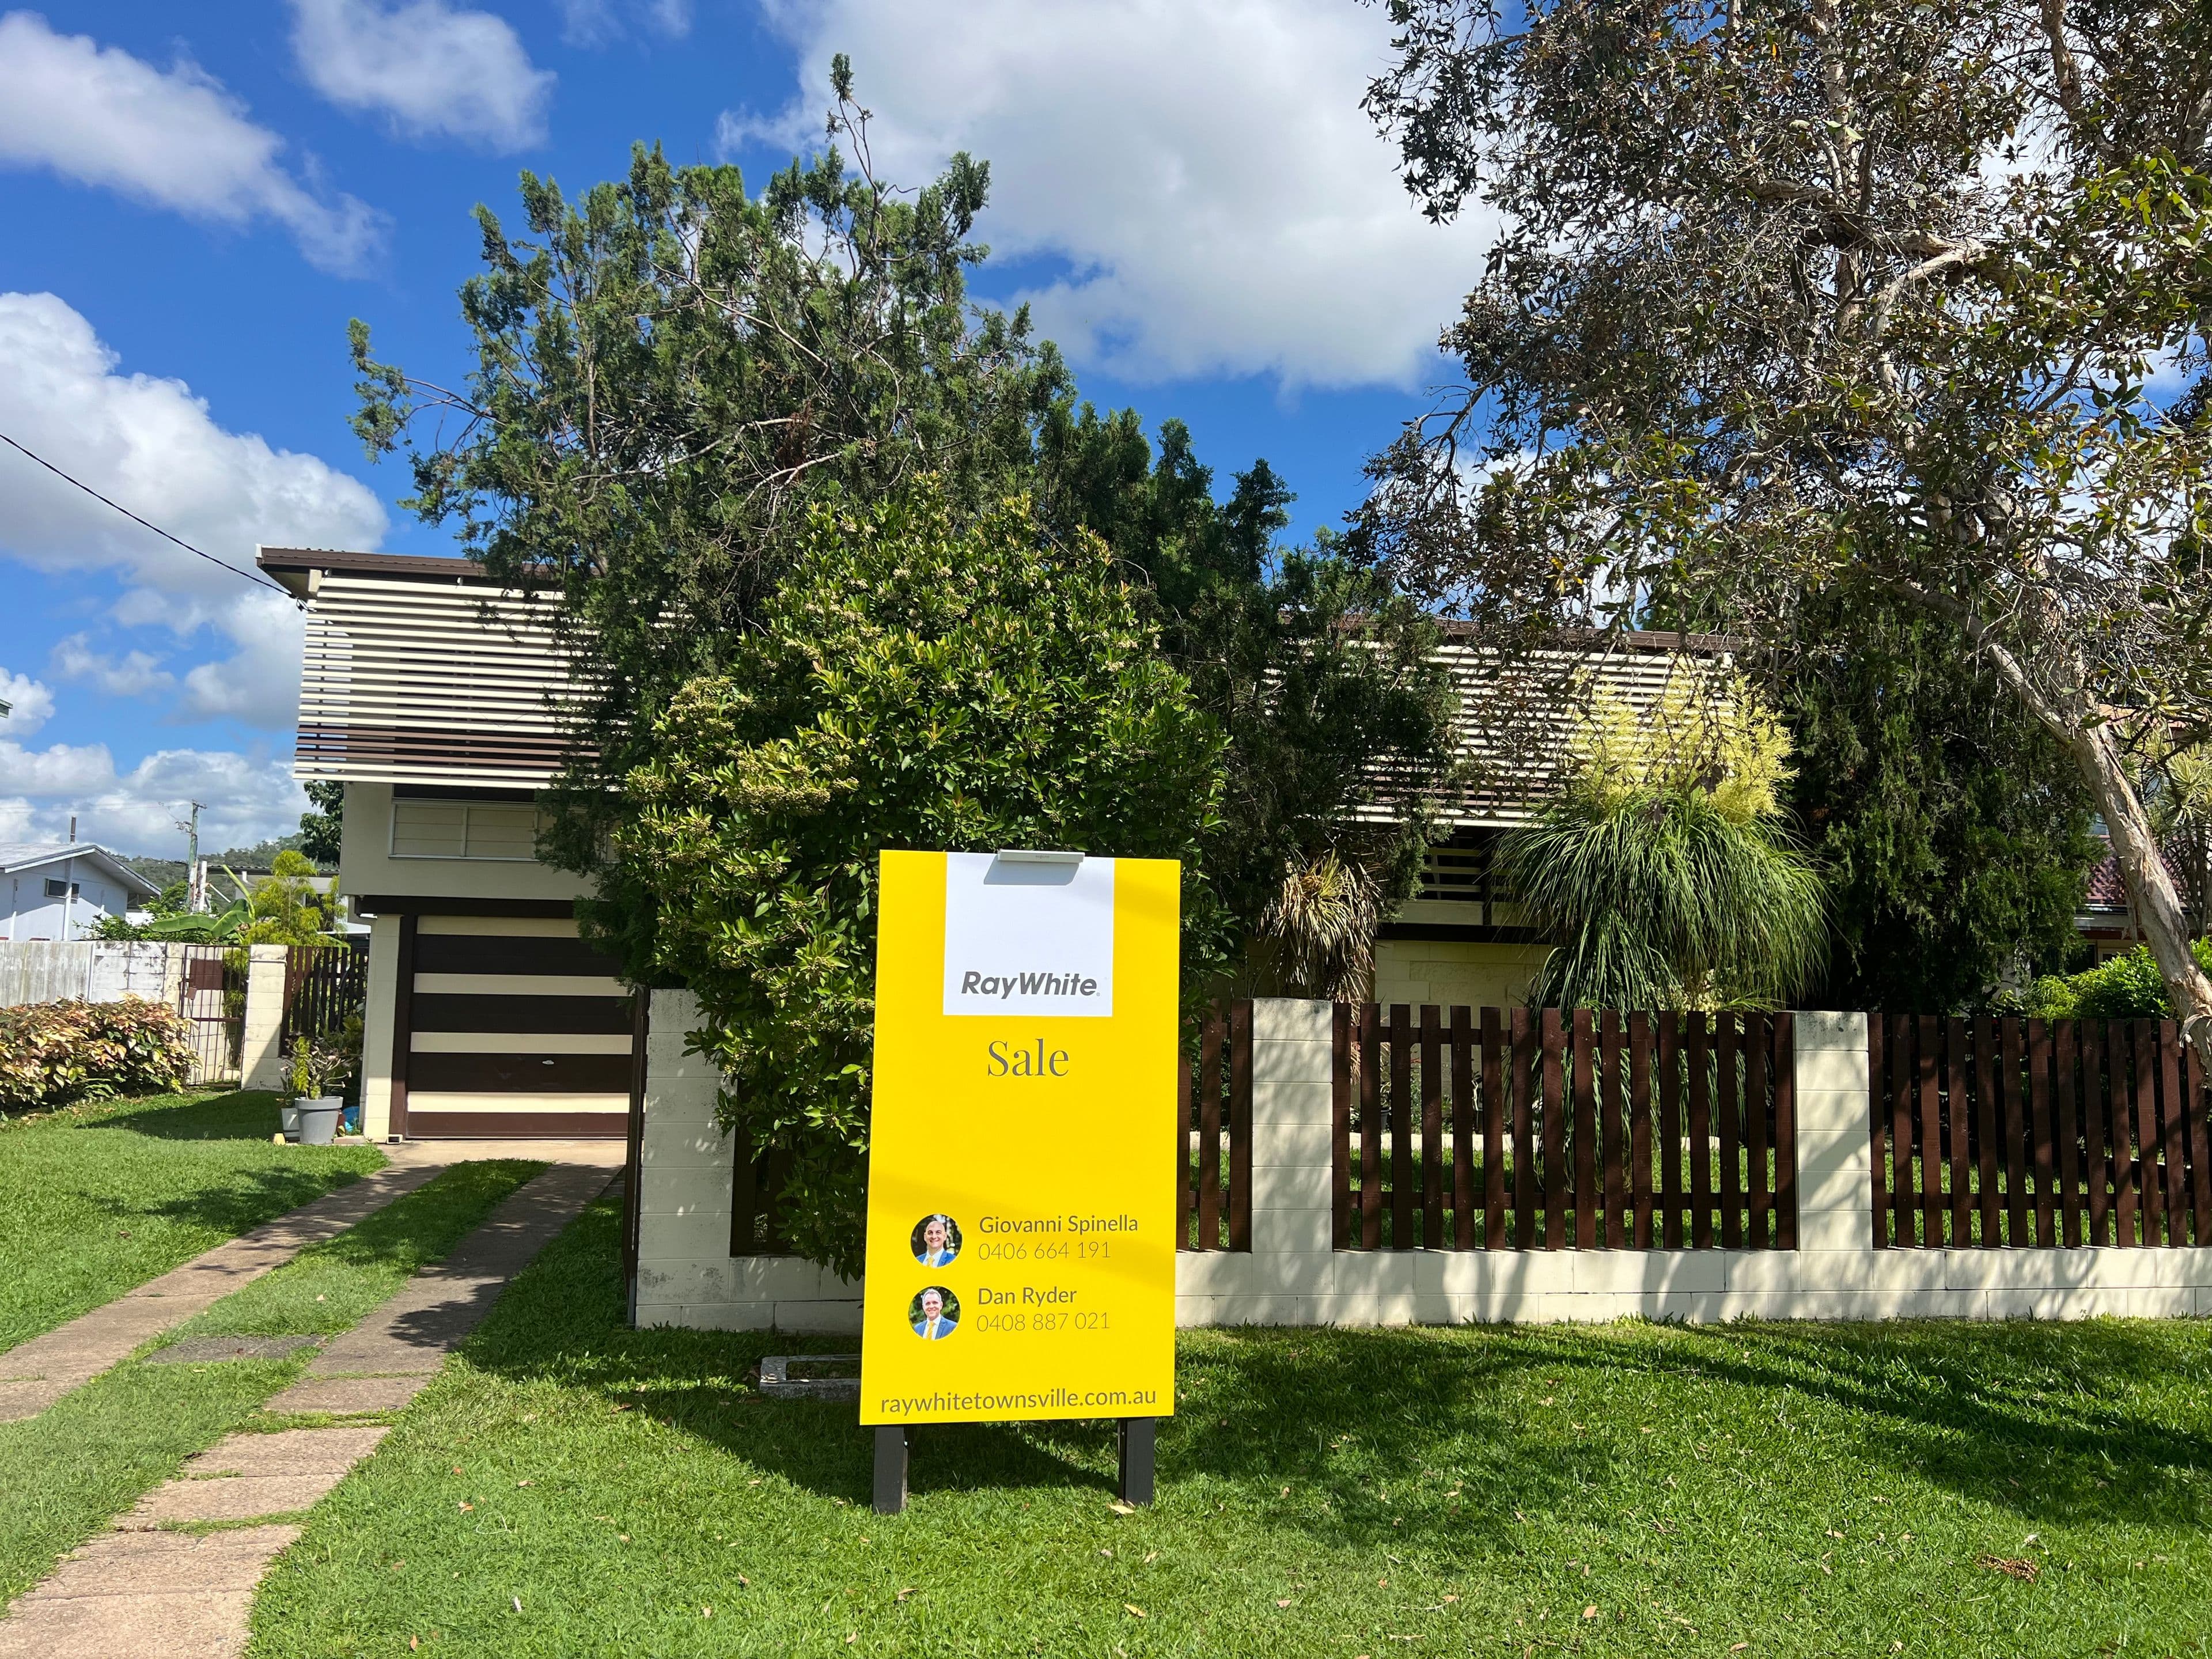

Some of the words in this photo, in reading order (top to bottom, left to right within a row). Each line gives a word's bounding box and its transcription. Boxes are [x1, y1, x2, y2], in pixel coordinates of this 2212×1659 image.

[987, 1038, 1069, 1077] Sale
[979, 1215, 1062, 1234] Giovanni
[1067, 1214, 1138, 1236] Spinella
[978, 1243, 1027, 1260] 0406
[1034, 1241, 1070, 1259] 664
[1077, 1241, 1111, 1259] 191
[978, 1287, 1016, 1305] Dan
[1022, 1286, 1077, 1308] Ryder
[976, 1314, 1025, 1332] 0408
[1033, 1313, 1069, 1331] 887
[1075, 1312, 1110, 1330] 021
[881, 1388, 1157, 1416] raywhitetownsville.com.au
